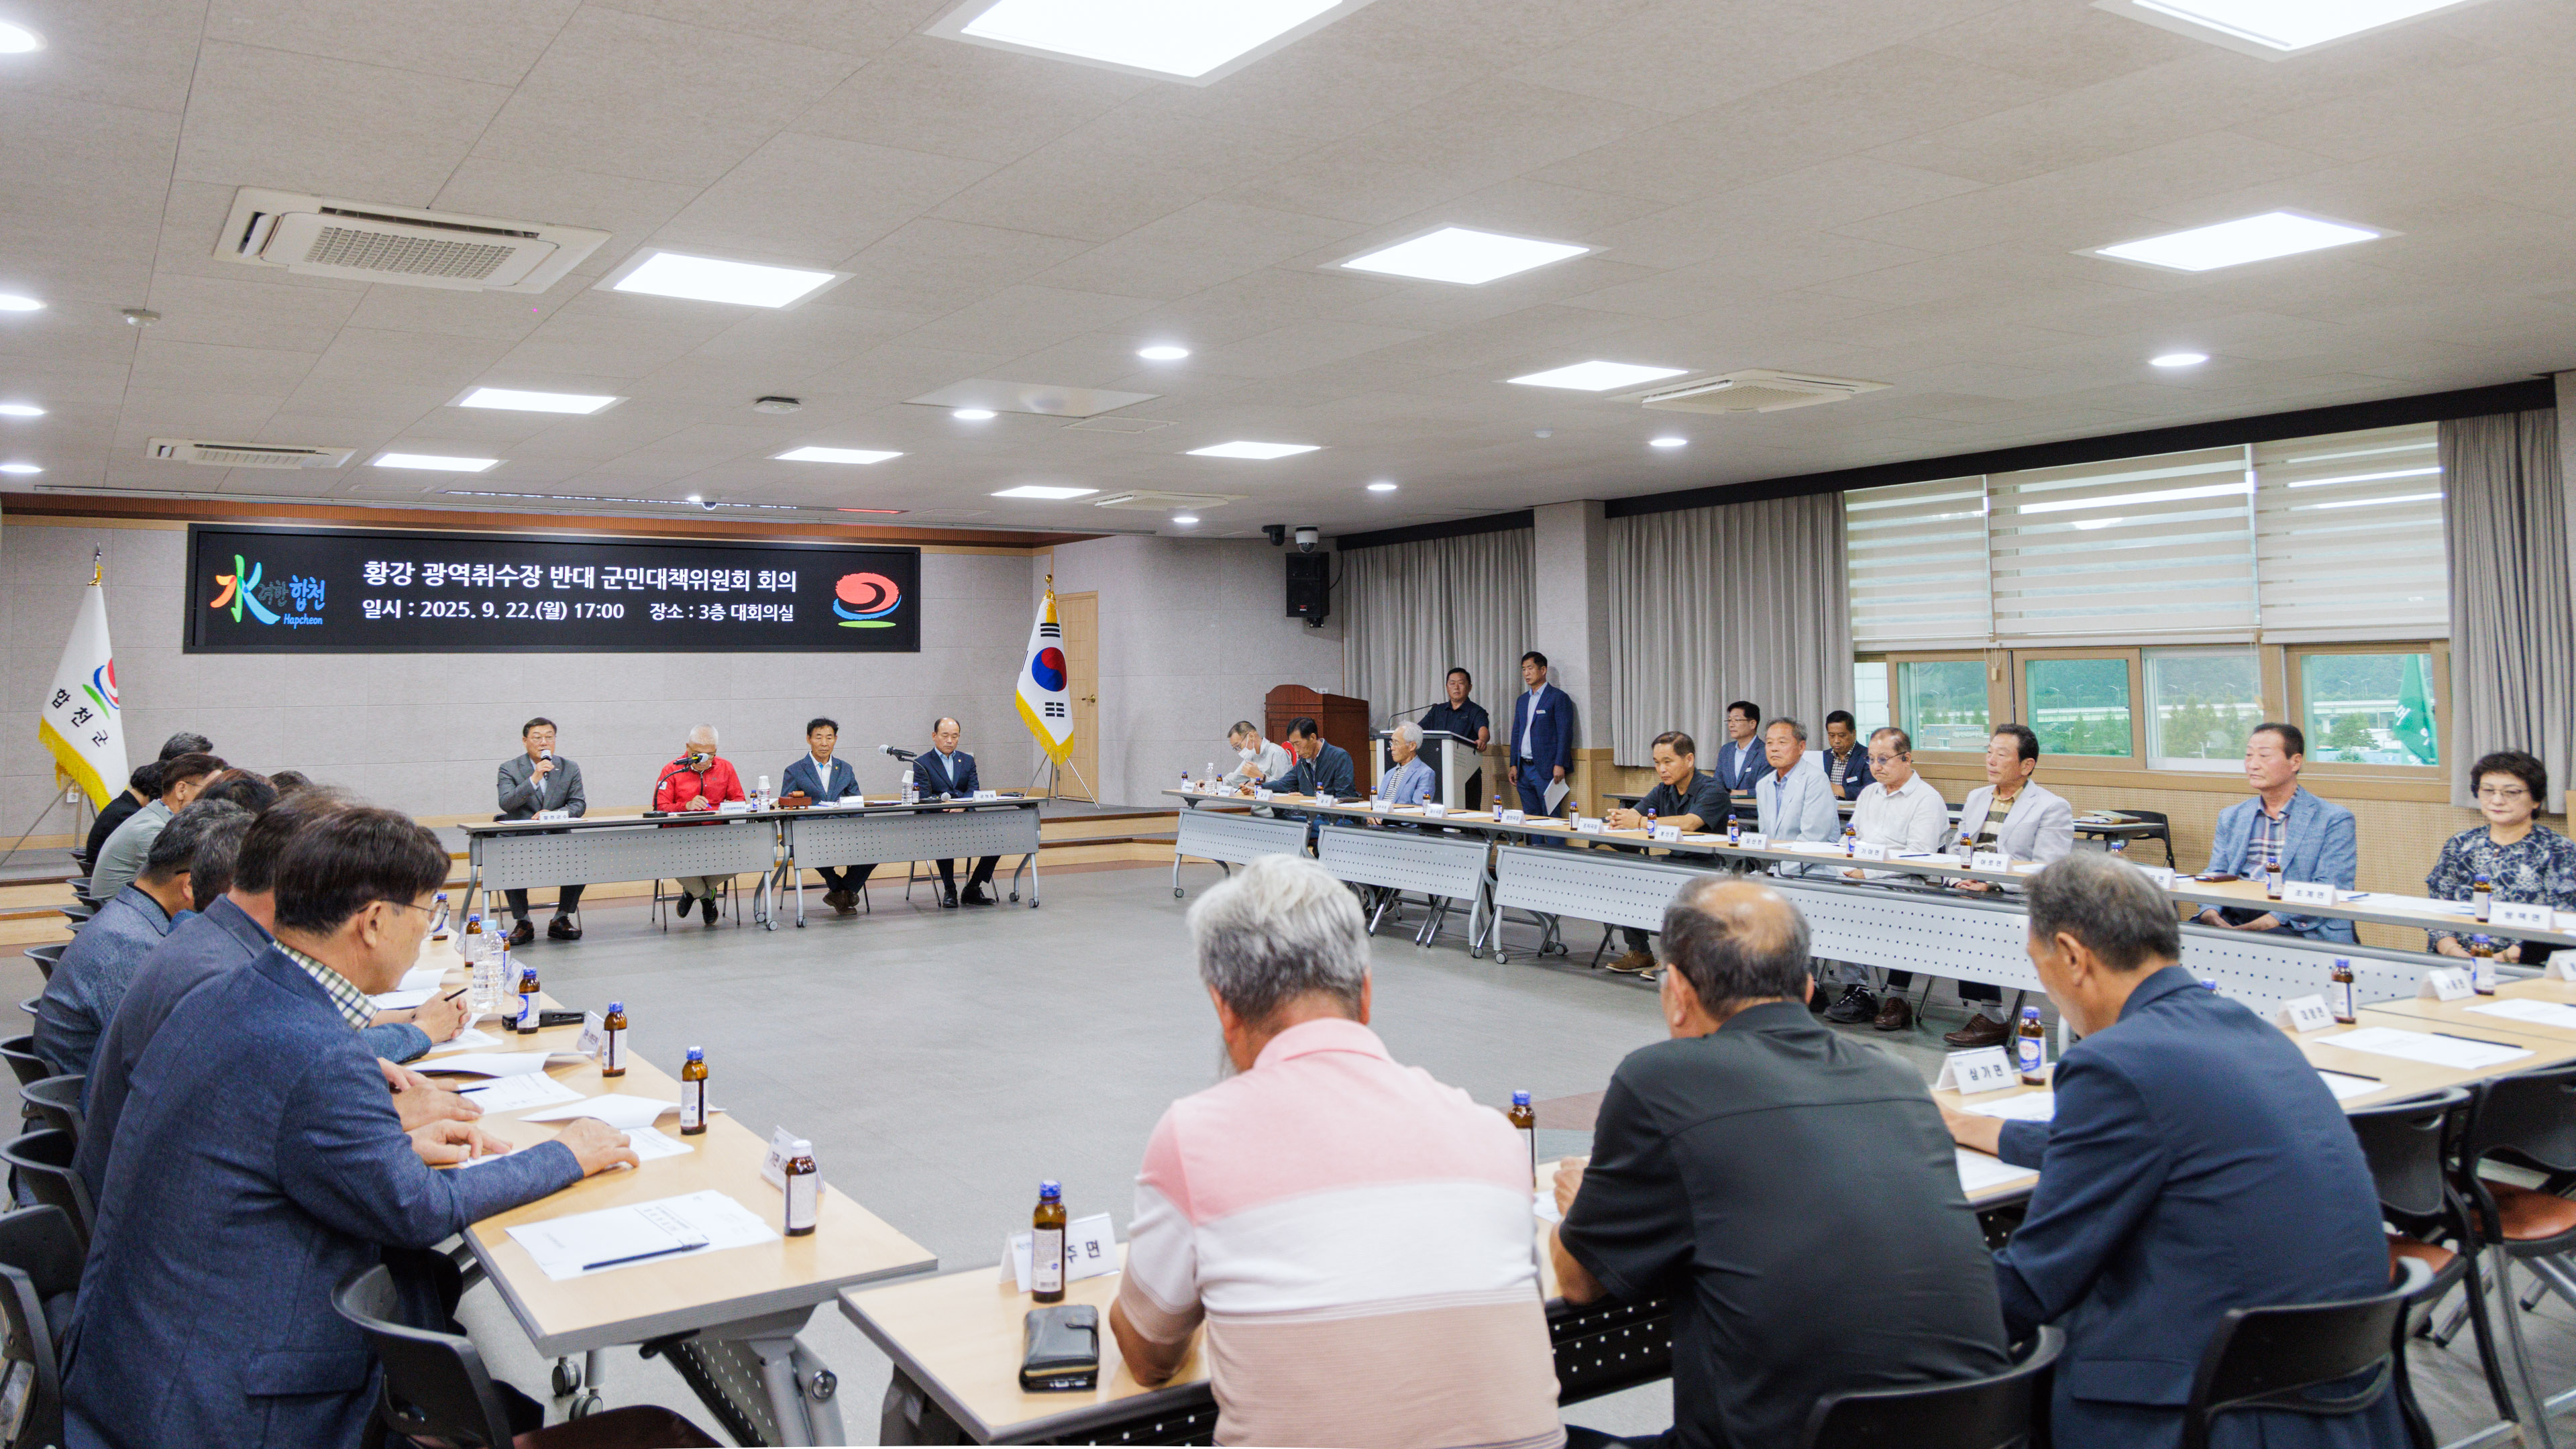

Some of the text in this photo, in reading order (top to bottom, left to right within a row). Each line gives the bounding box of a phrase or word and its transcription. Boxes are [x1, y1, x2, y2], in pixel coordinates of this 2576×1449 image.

[363, 561, 796, 592] 황강 광역취수장 반대 군민대책위원회 회의
[283, 613, 323, 629] Hapcheon
[362, 599, 401, 619] 일시
[420, 601, 476, 619] 2025.
[482, 602, 500, 619] 9.
[505, 601, 568, 621] 22.(월)
[574, 602, 625, 619] 17:00
[649, 602, 684, 621] 장소
[698, 603, 727, 621] 3층
[731, 604, 794, 622] 대회의실
[1067, 1240, 1101, 1263] 주면
